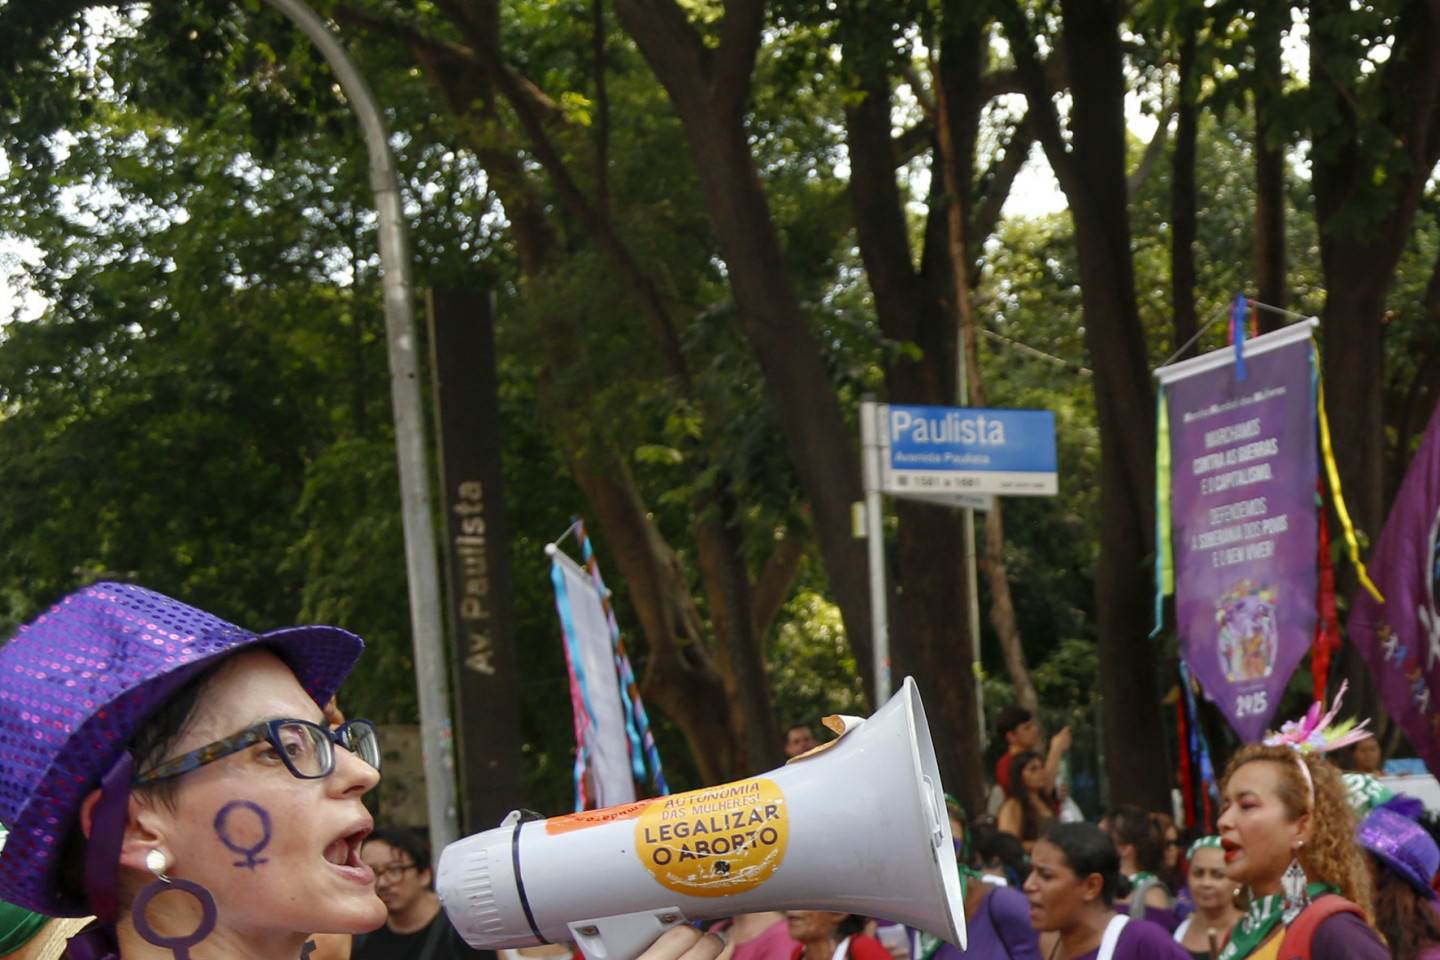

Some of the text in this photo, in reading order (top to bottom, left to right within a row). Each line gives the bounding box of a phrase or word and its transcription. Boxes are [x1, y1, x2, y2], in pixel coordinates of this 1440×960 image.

[892, 410, 1006, 445] Paulista
[944, 453, 991, 464] Paulista
[453, 480, 492, 619] Paulista
[663, 782, 760, 809] AUTONOMIA
[661, 808, 687, 821] DAS
[653, 827, 779, 866] O ABORTO
